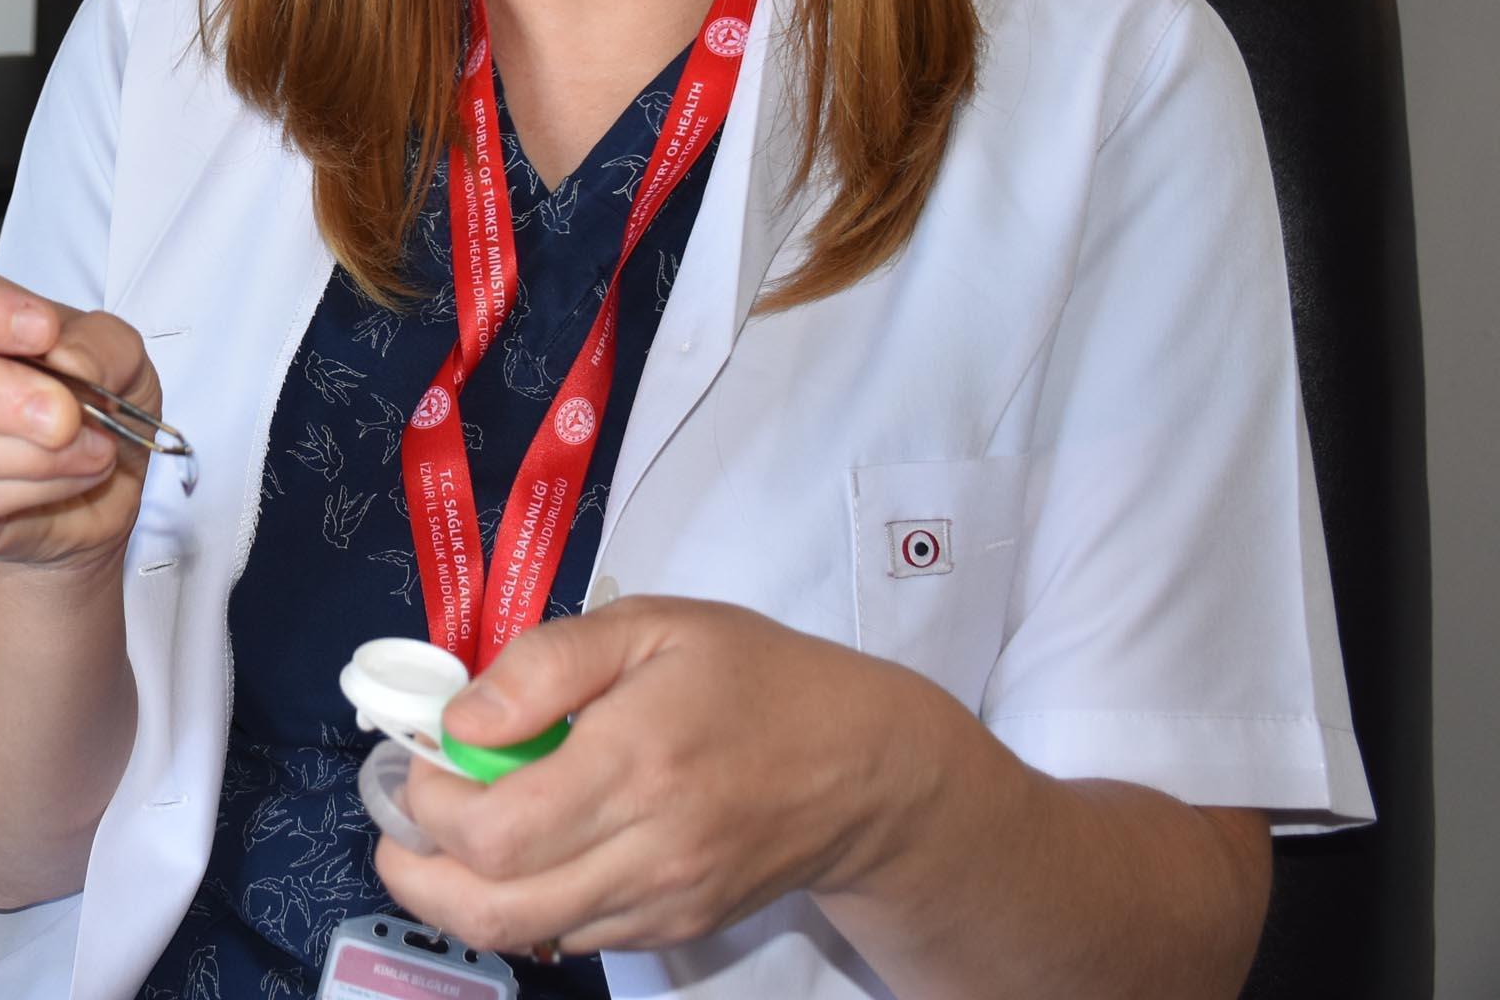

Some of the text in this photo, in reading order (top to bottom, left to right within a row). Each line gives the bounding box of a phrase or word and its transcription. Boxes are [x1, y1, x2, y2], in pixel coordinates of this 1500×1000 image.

[473, 98, 490, 166] REPUBLIC
[631, 159, 670, 218] MINISTRY
[666, 138, 682, 157] OF
[677, 81, 704, 136] HEALTH
[662, 115, 708, 185] DIRECTORATE
[462, 168, 479, 237] PROVINCIAL
[478, 167, 492, 187] OF
[481, 189, 499, 243] TURKEY
[467, 239, 483, 285] HEALTH
[487, 246, 506, 318] MINISTRY
[428, 516, 447, 560] SAĞLIK
[512, 479, 549, 560] BAKANLIĞI
[534, 477, 569, 559] MÜDÜRLÜĞÜ
[439, 469, 472, 640] T.C. SAĞLIK BAKANLIĞI
[517, 559, 542, 608] SAĞLIK
[437, 563, 457, 652] MÜDÜRLÜĞÜ
[498, 561, 522, 617] SAĞLIK
[513, 611, 526, 622] İL
[493, 620, 507, 645] T.C.
